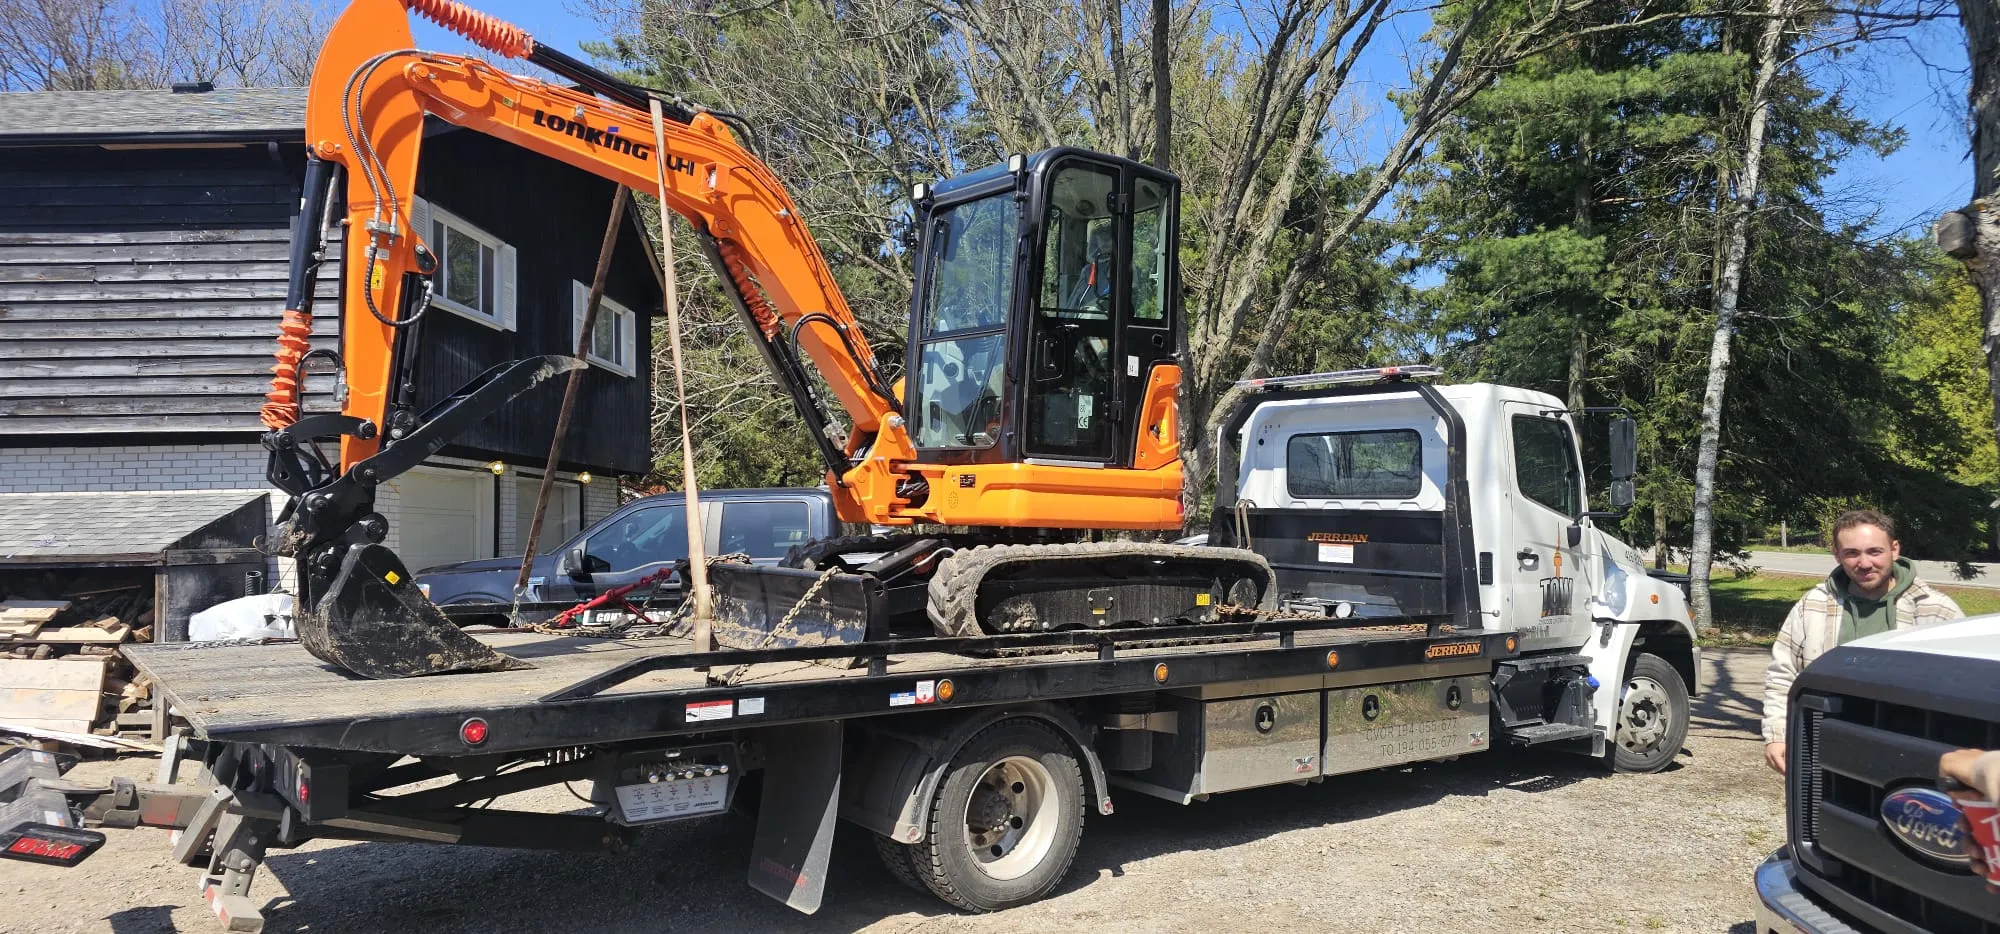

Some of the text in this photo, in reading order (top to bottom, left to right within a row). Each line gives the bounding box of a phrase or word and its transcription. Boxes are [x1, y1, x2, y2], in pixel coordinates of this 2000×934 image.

[1540, 577, 1573, 613] TOW
[1380, 735, 1457, 757] TO 194-055-677
[1897, 800, 1958, 849] Ford
